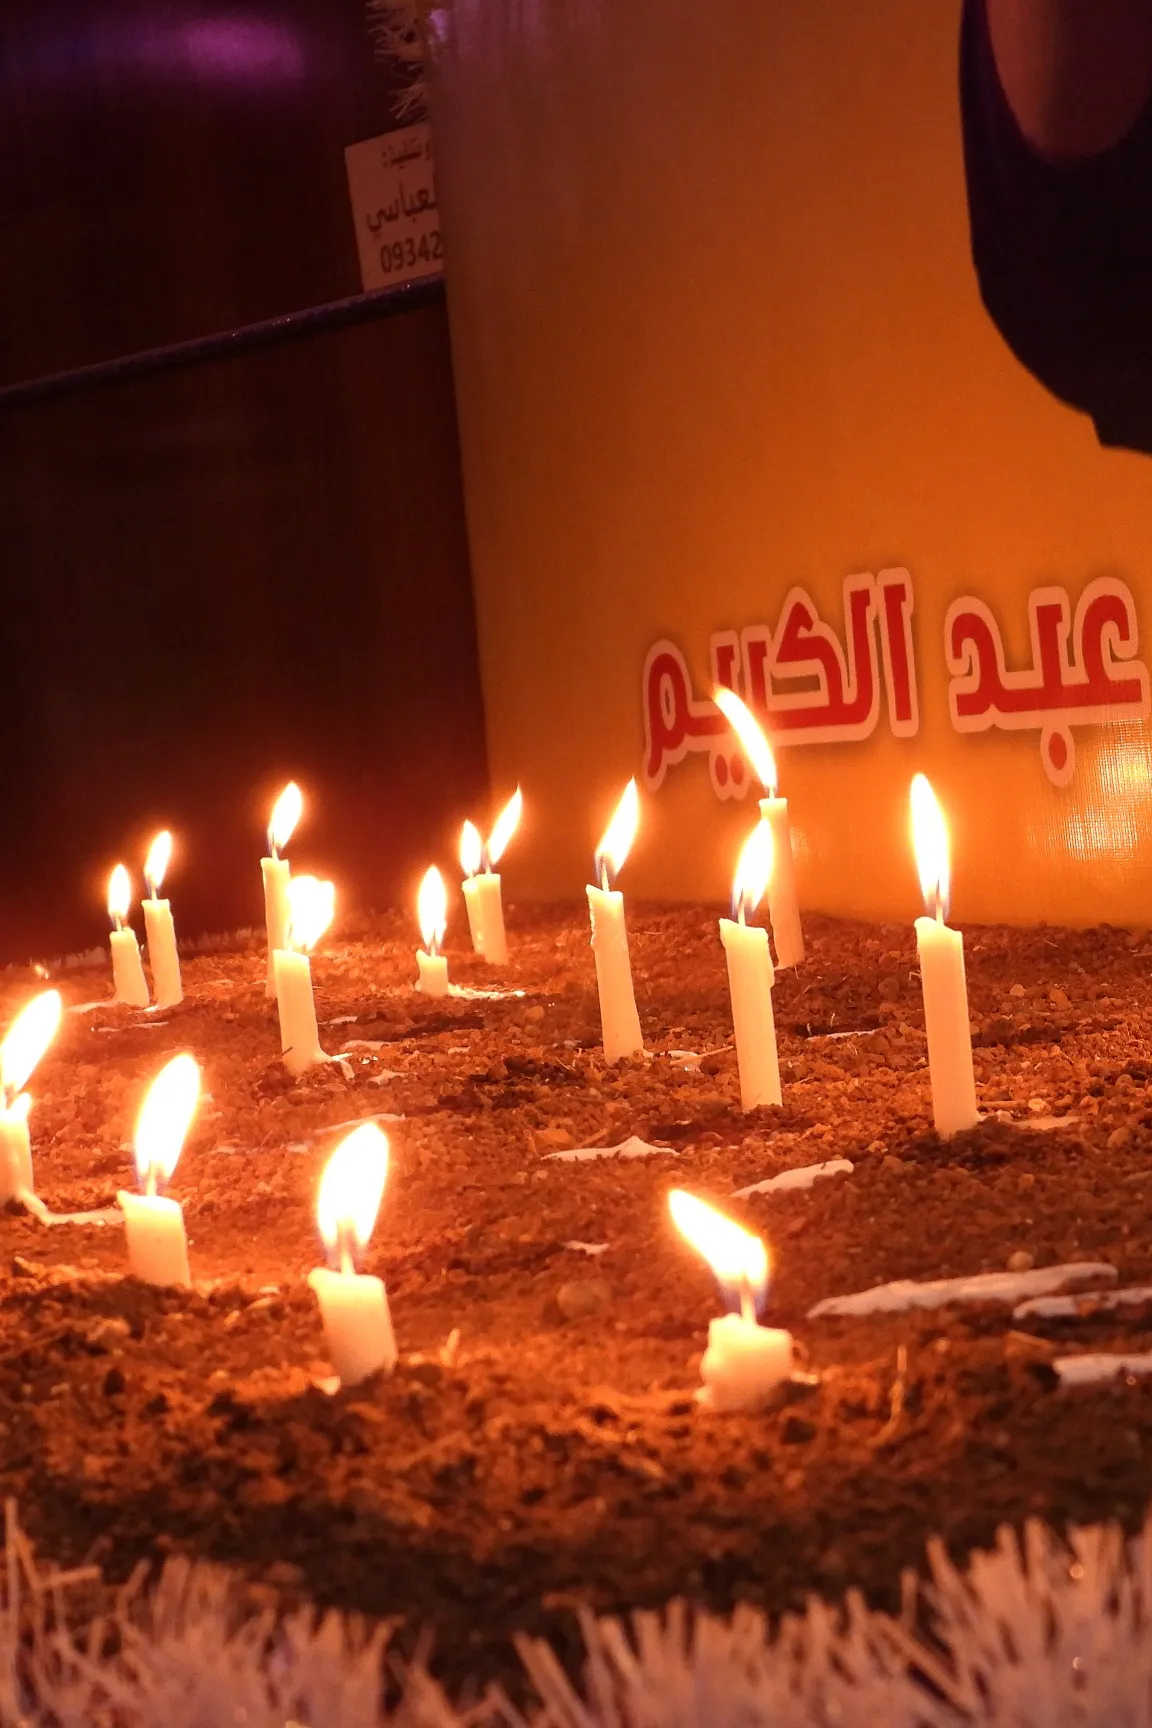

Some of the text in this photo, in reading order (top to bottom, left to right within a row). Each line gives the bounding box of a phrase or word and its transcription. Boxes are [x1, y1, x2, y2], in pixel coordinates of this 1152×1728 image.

[366, 182, 437, 240] عباسي
[645, 568, 917, 798] الكريم
[947, 580, 1148, 784] عبد
